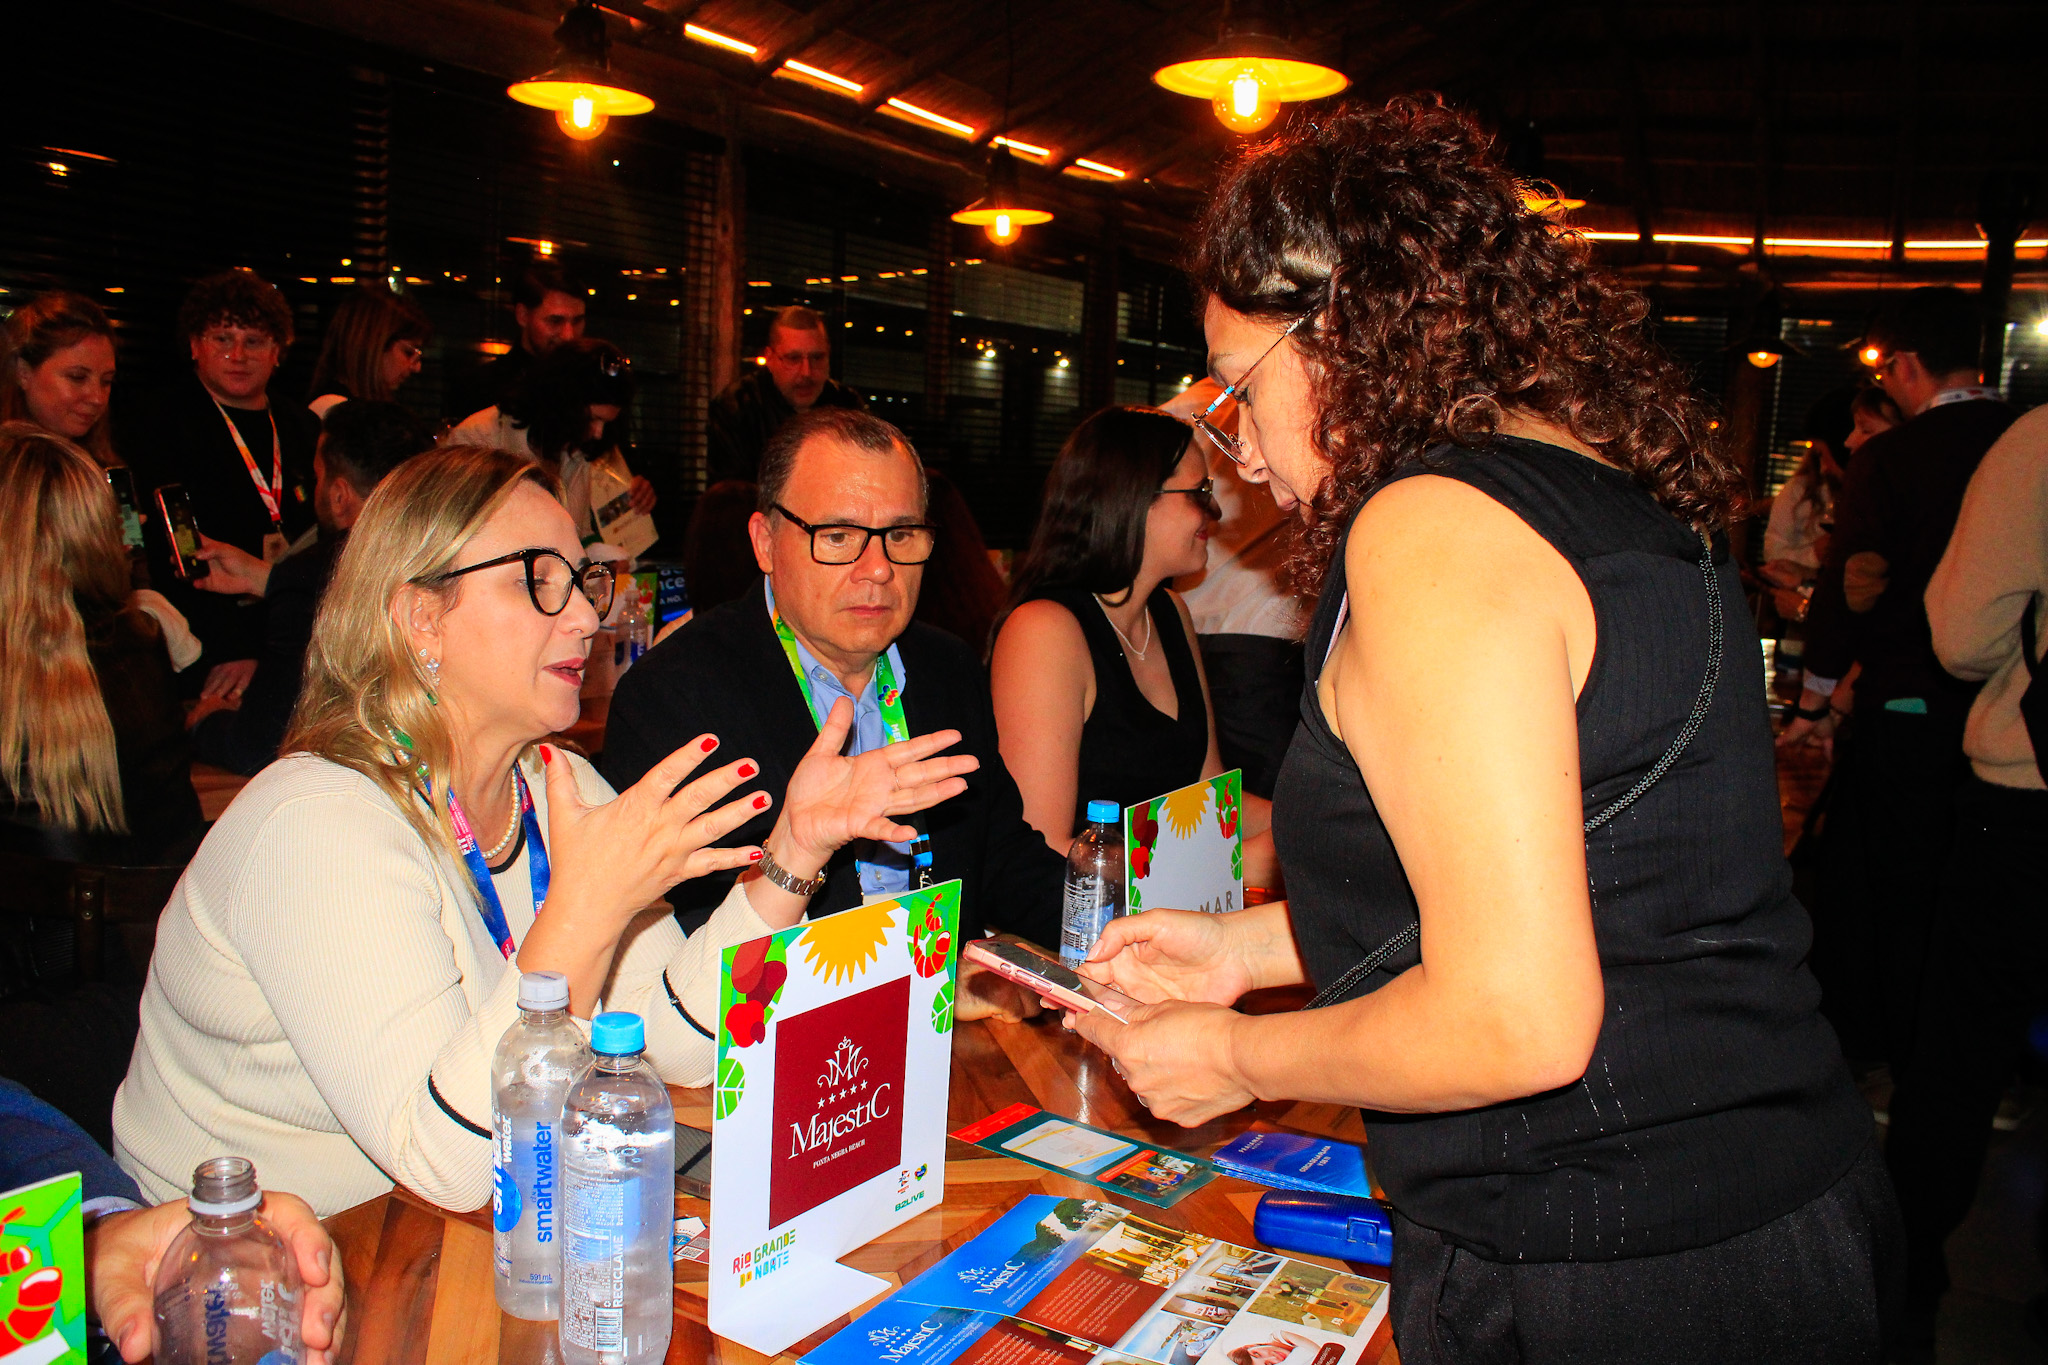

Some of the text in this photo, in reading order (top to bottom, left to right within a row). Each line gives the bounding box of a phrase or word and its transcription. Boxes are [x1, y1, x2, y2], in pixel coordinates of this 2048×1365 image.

[1189, 890, 1234, 914] MAR
[812, 1138, 866, 1169] PONTA NEGRA BEACH
[532, 1120, 553, 1244] smartwater
[754, 1228, 796, 1264] GRANDE
[613, 1234, 624, 1308] RECICLAME
[754, 1250, 789, 1280] NORTE
